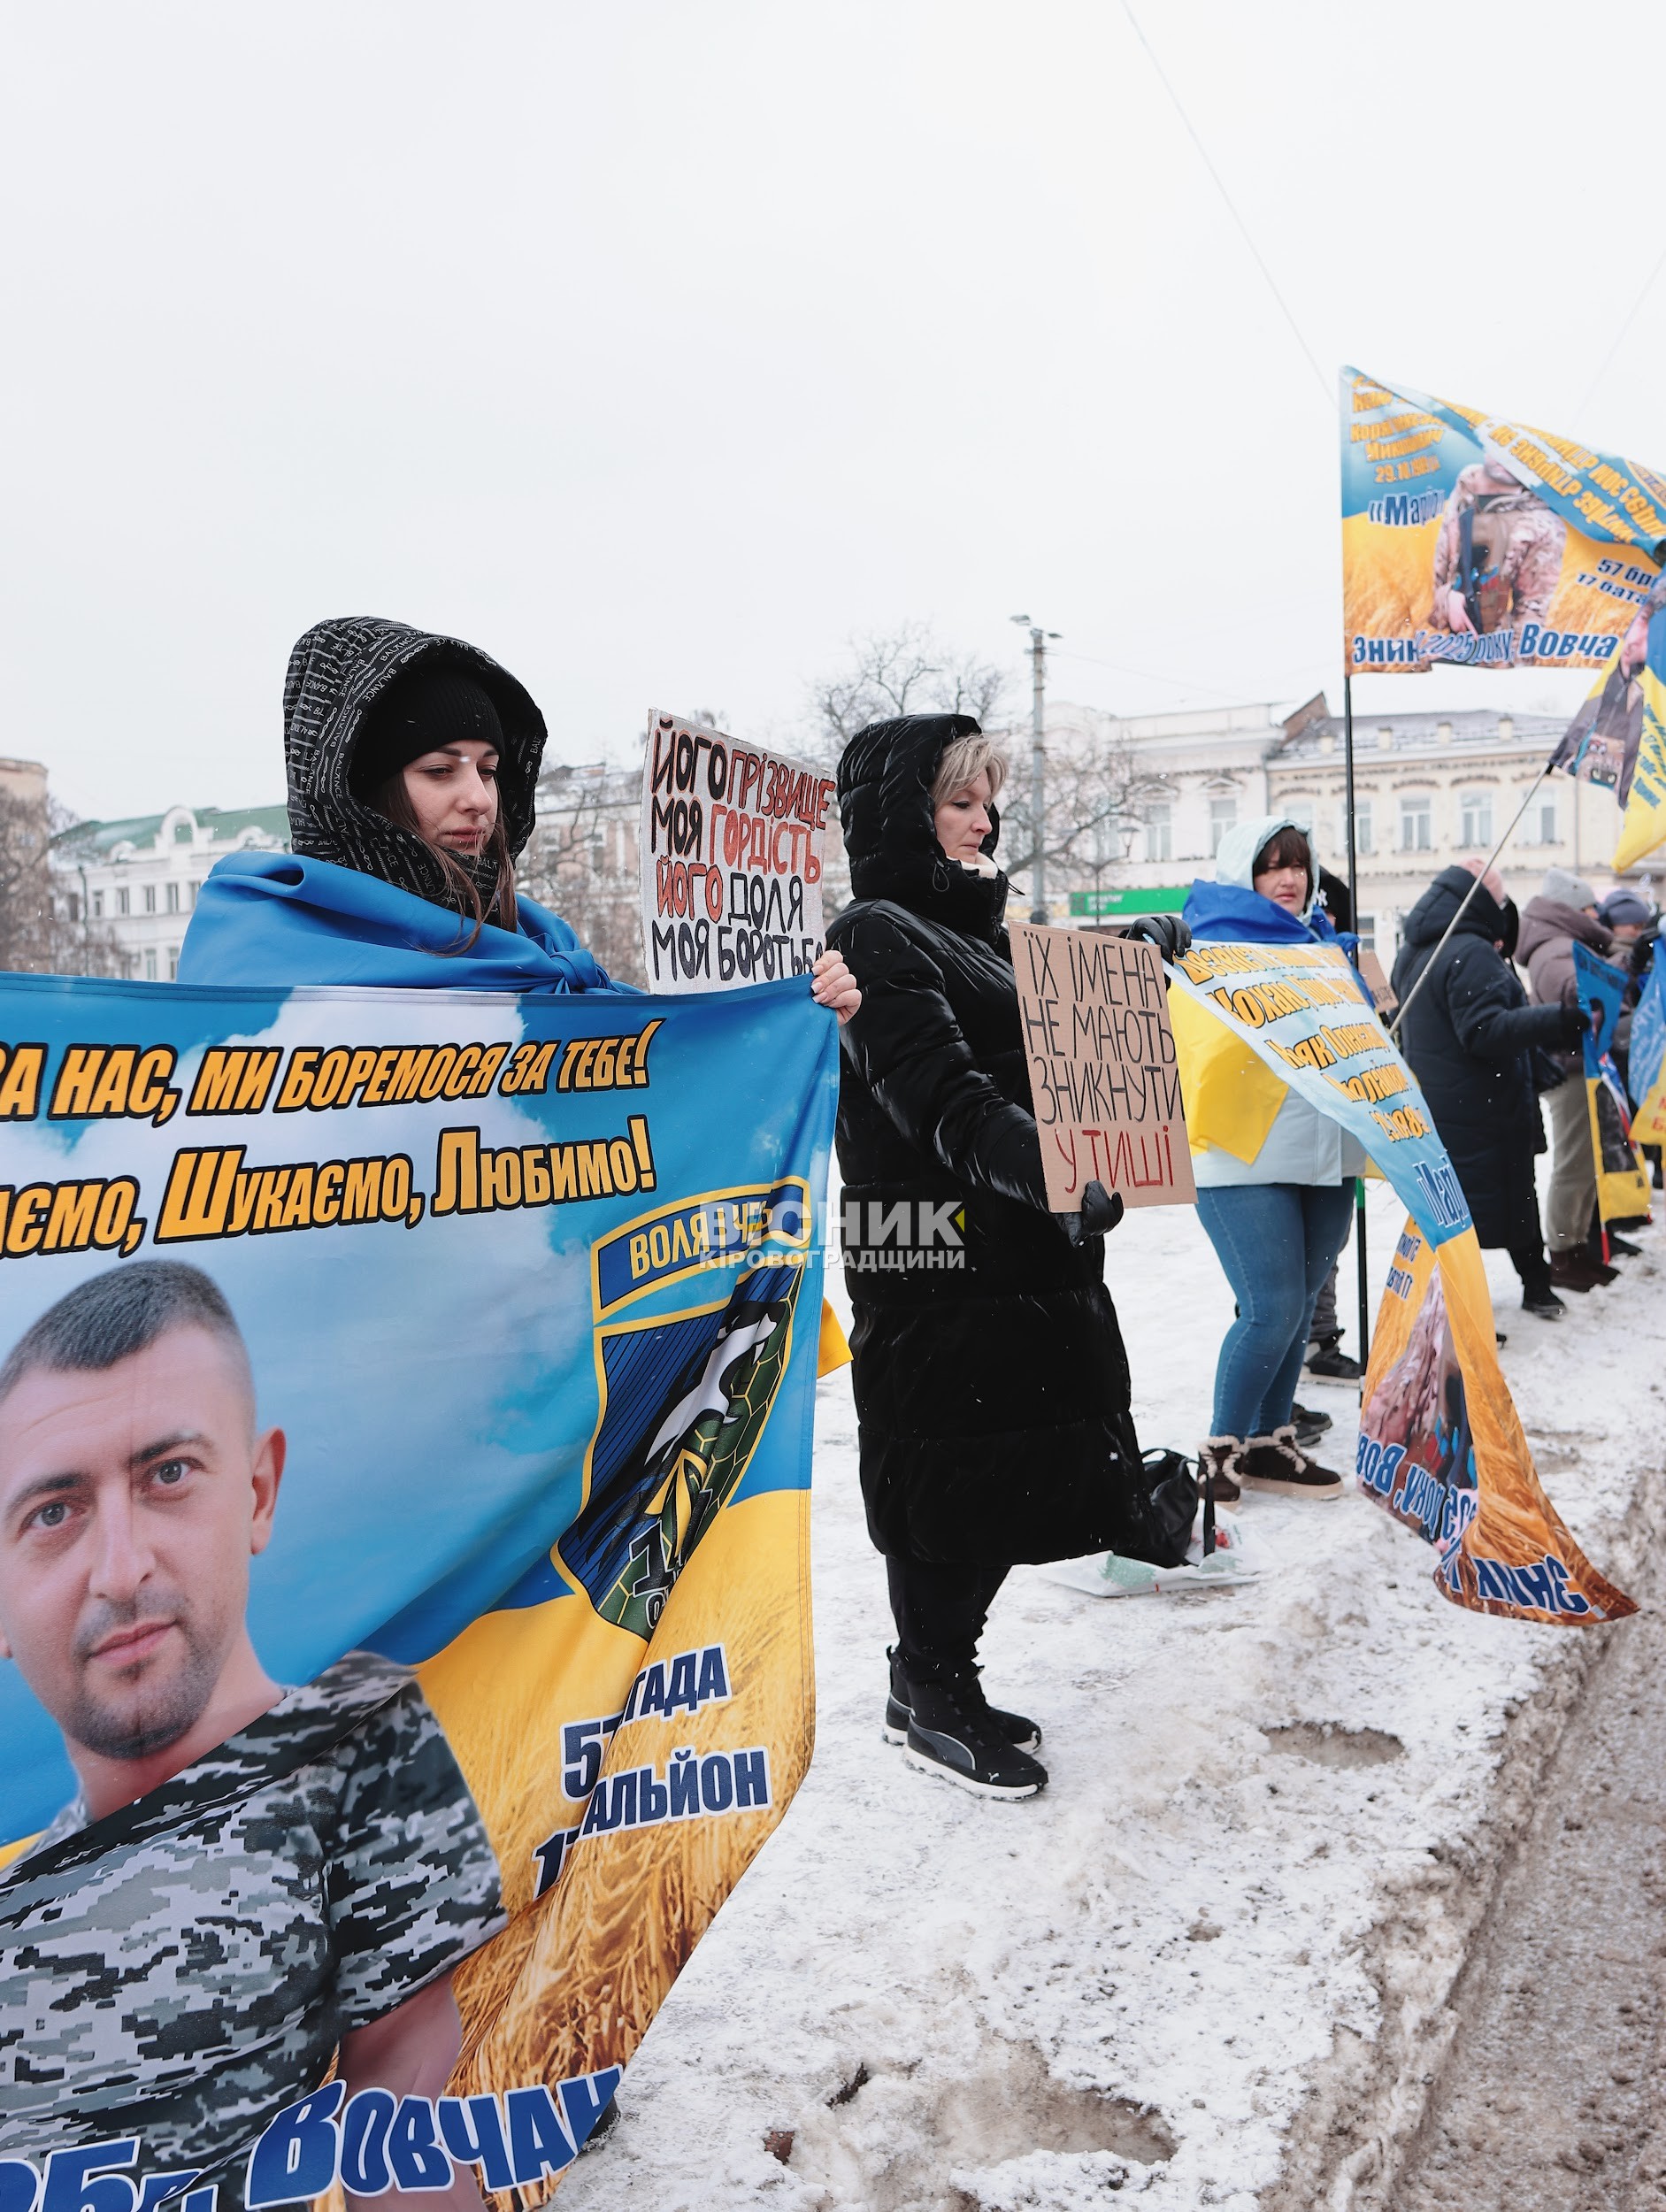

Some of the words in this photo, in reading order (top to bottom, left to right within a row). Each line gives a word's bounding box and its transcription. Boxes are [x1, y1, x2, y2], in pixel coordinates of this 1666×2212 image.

[1577, 573, 1598, 587] 17
[1596, 557, 1624, 577] 57
[650, 718, 727, 801] ЙОГО
[726, 749, 835, 831] ПРІЗВИЩЕ
[651, 794, 702, 862] МОЯ
[710, 803, 821, 885] ГОРДІСТЬ
[656, 854, 724, 924] ЙОГО
[728, 872, 803, 933] ДОЛЯ
[652, 918, 710, 982] МОЯ
[1024, 930, 1060, 999] ЇХ
[1067, 936, 1163, 1009] ІМЕНА
[1022, 995, 1066, 1057] НЕ
[1072, 1002, 1176, 1064] МАЮТЬ
[0, 1041, 48, 1122] А
[47, 1043, 183, 1129] НАС,
[185, 1043, 280, 1118] МИ
[273, 1038, 512, 1115] БОРЕМОСЯ
[499, 1037, 553, 1094] ЗА
[554, 1018, 667, 1094] ТЕБЕ!
[1033, 1056, 1186, 1125] ЗНИКНУТИ
[629, 1210, 710, 1280] ВОЛЯ
